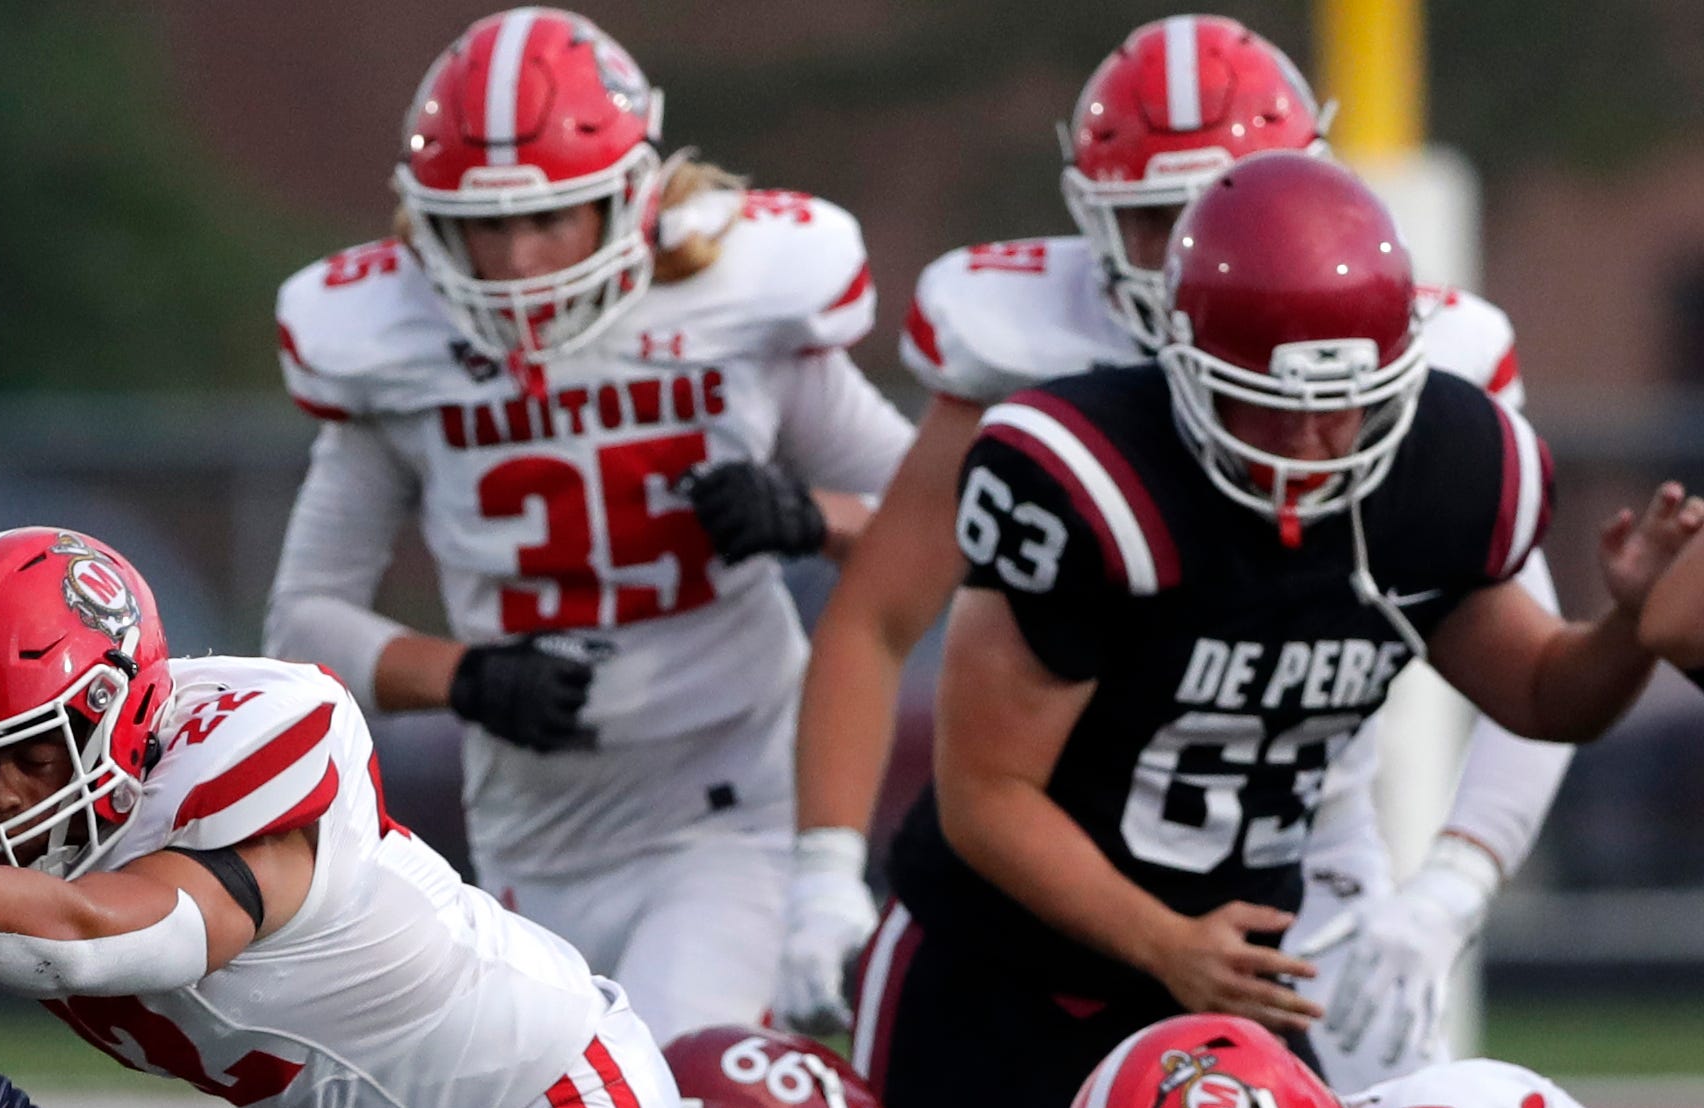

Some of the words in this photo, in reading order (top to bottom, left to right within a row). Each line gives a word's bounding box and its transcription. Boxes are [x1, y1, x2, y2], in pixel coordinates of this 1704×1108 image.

[478, 430, 718, 635] 35
[956, 465, 1068, 595] 63
[1174, 637, 1264, 709] DE
[167, 690, 264, 752] 22
[721, 1036, 814, 1104] 66
